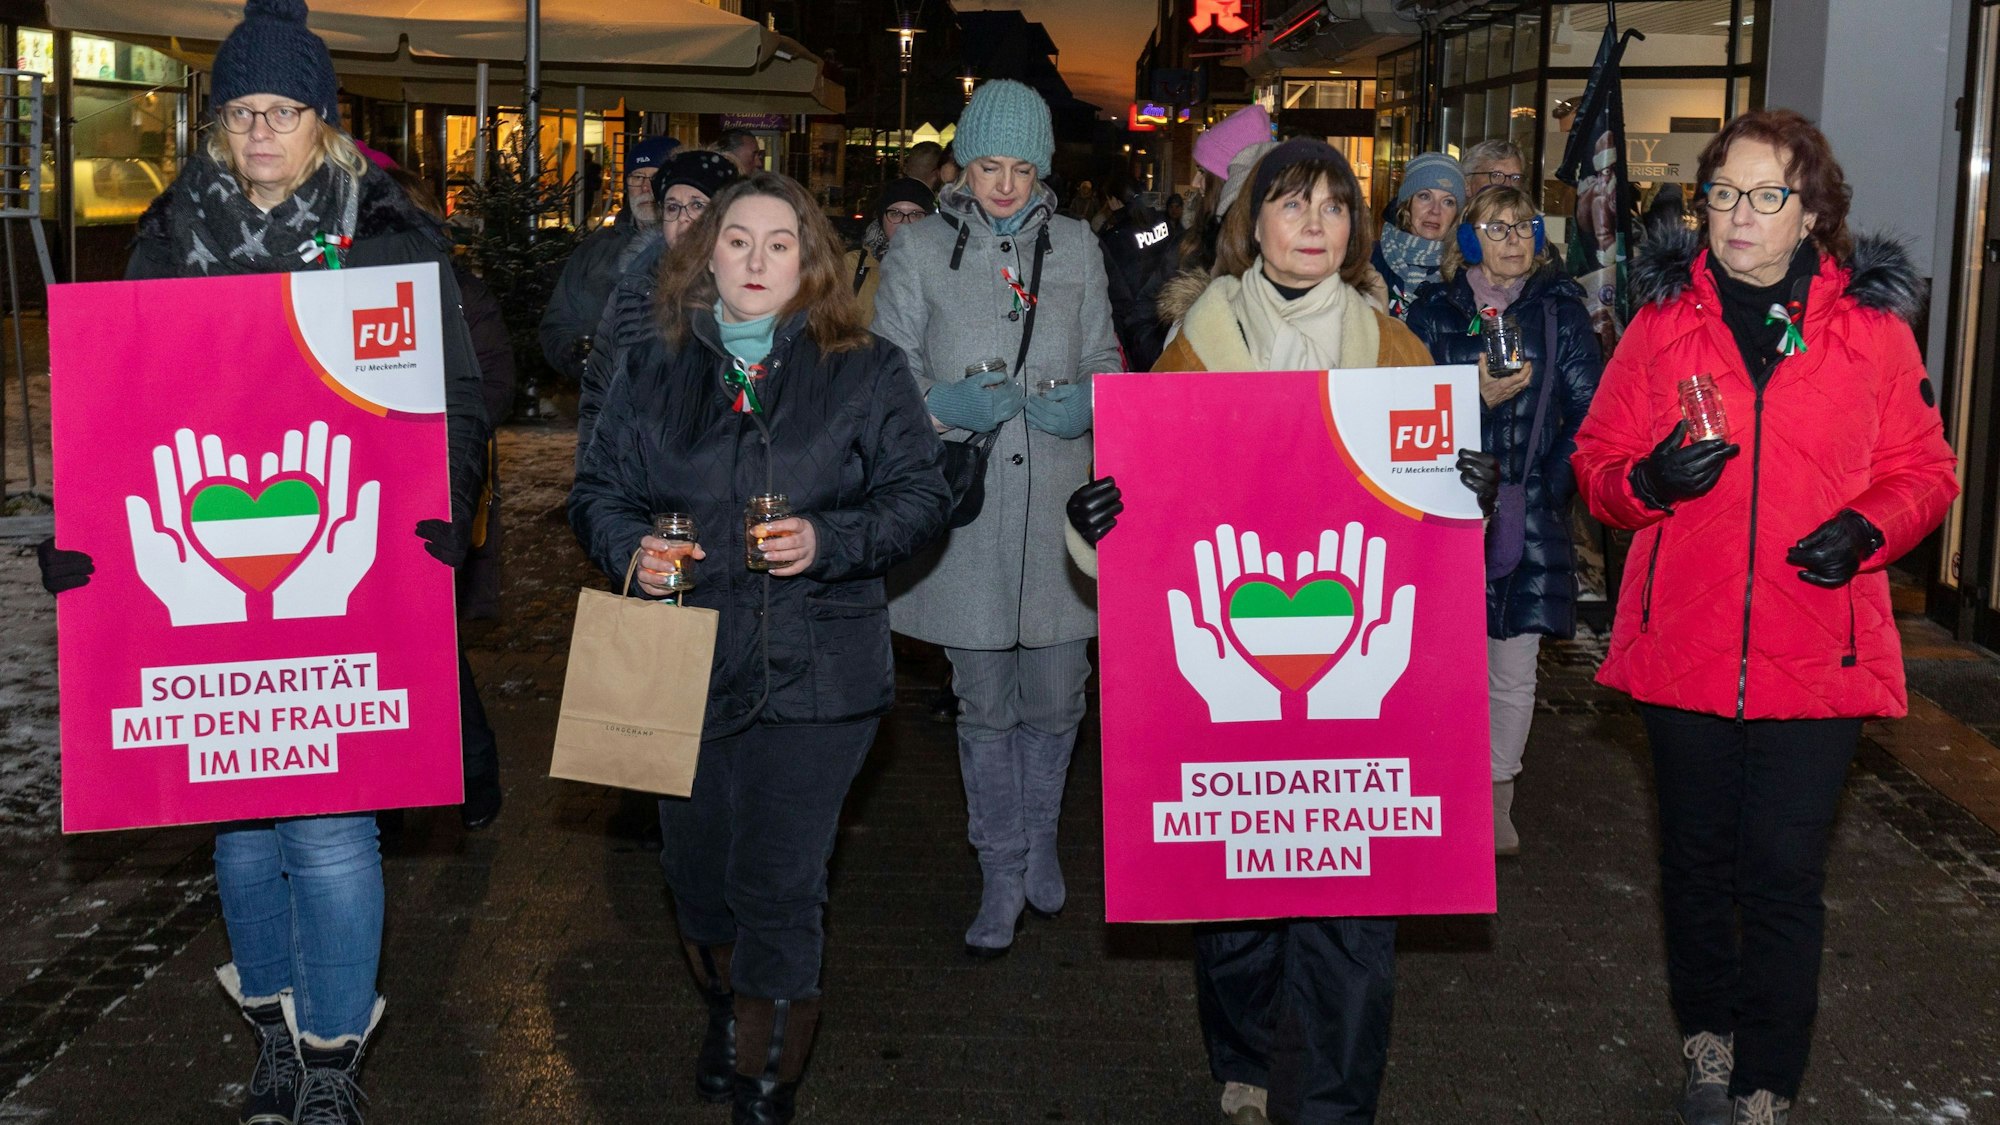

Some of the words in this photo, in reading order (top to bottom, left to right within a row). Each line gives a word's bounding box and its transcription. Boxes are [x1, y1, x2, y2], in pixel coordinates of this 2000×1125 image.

[1142, 103, 1165, 117] dm
[636, 156, 651, 164] FILA
[1628, 166, 1680, 177] FRISEUR
[1134, 221, 1169, 249] POLIZEI
[359, 306, 412, 348] FU!
[368, 361, 417, 371] Meckenheim
[1395, 409, 1450, 450] FU!
[1404, 465, 1455, 474] Meckenheim
[151, 657, 372, 702] SOLIDARITÄT
[122, 714, 184, 743] MIT
[193, 709, 261, 738] DEN
[271, 699, 401, 733] FRAUEN
[606, 724, 654, 737] LONGCHAMP
[200, 749, 241, 776] IM
[250, 743, 330, 773] IRAN
[1191, 761, 1404, 798] SOLIDARITÄT
[1163, 811, 1222, 837] MIT
[1231, 809, 1295, 835] DEN
[1305, 806, 1433, 833] FRAUEN
[1236, 848, 1275, 873] IM
[1285, 846, 1362, 872] IRAN
